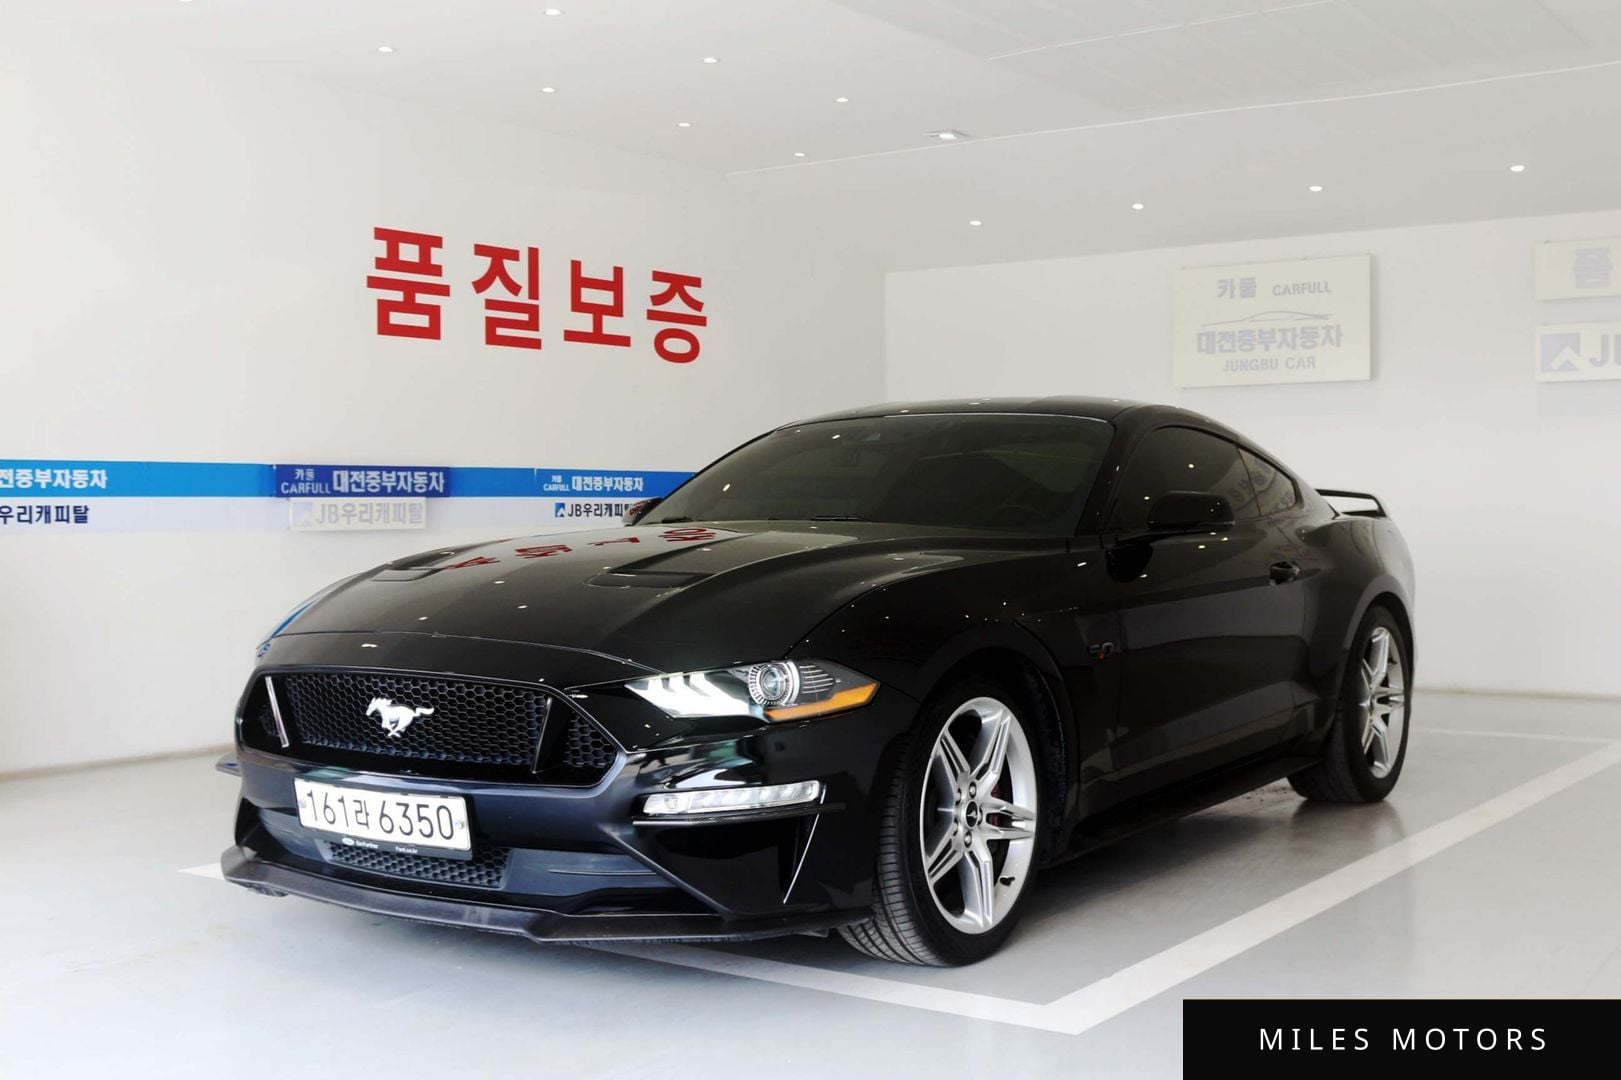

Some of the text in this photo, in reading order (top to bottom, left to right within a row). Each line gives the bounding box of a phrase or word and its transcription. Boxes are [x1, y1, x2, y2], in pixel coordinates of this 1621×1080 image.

[367, 227, 707, 363] 품질보증
[1272, 281, 1332, 296] CARFULL
[1196, 324, 1343, 354] 대전중부자동차
[1222, 356, 1316, 372] JUNGBU CAR
[281, 482, 331, 494] CARFULL
[333, 470, 445, 493] 대전중부자동차
[572, 476, 644, 492] 대전중부자동차
[316, 502, 424, 525] JB우리캐피탈
[568, 503, 630, 517] JB우리캐피
